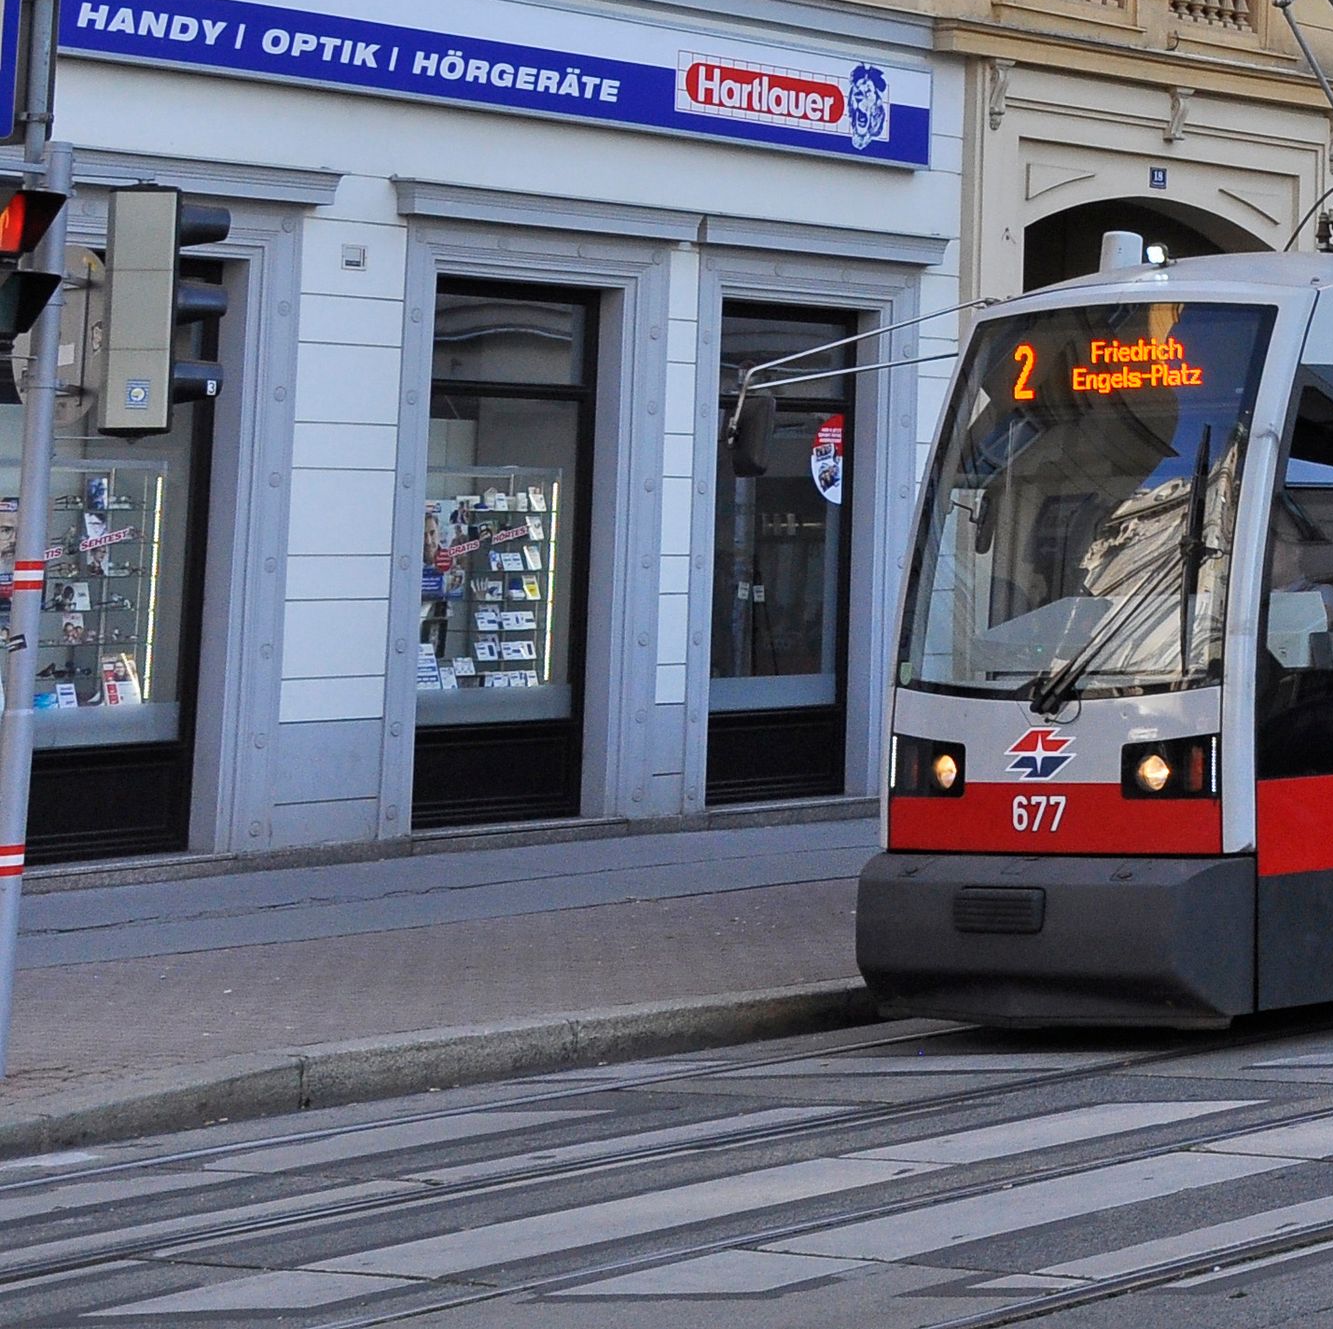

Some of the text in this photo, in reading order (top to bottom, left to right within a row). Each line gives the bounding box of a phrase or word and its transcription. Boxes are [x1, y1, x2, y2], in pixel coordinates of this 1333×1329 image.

[76, 2, 621, 103] HANDY OPTIK HÖRGERÄTE
[697, 65, 834, 121] Hartlauer
[1090, 337, 1183, 364] Friedrich
[207, 381, 216, 394] 3
[1014, 345, 1035, 400] 2
[1072, 362, 1203, 394] Engels-Platz
[80, 528, 129, 551] SEHTEST
[449, 541, 480, 557] GRATIS
[1012, 794, 1067, 832] 677
